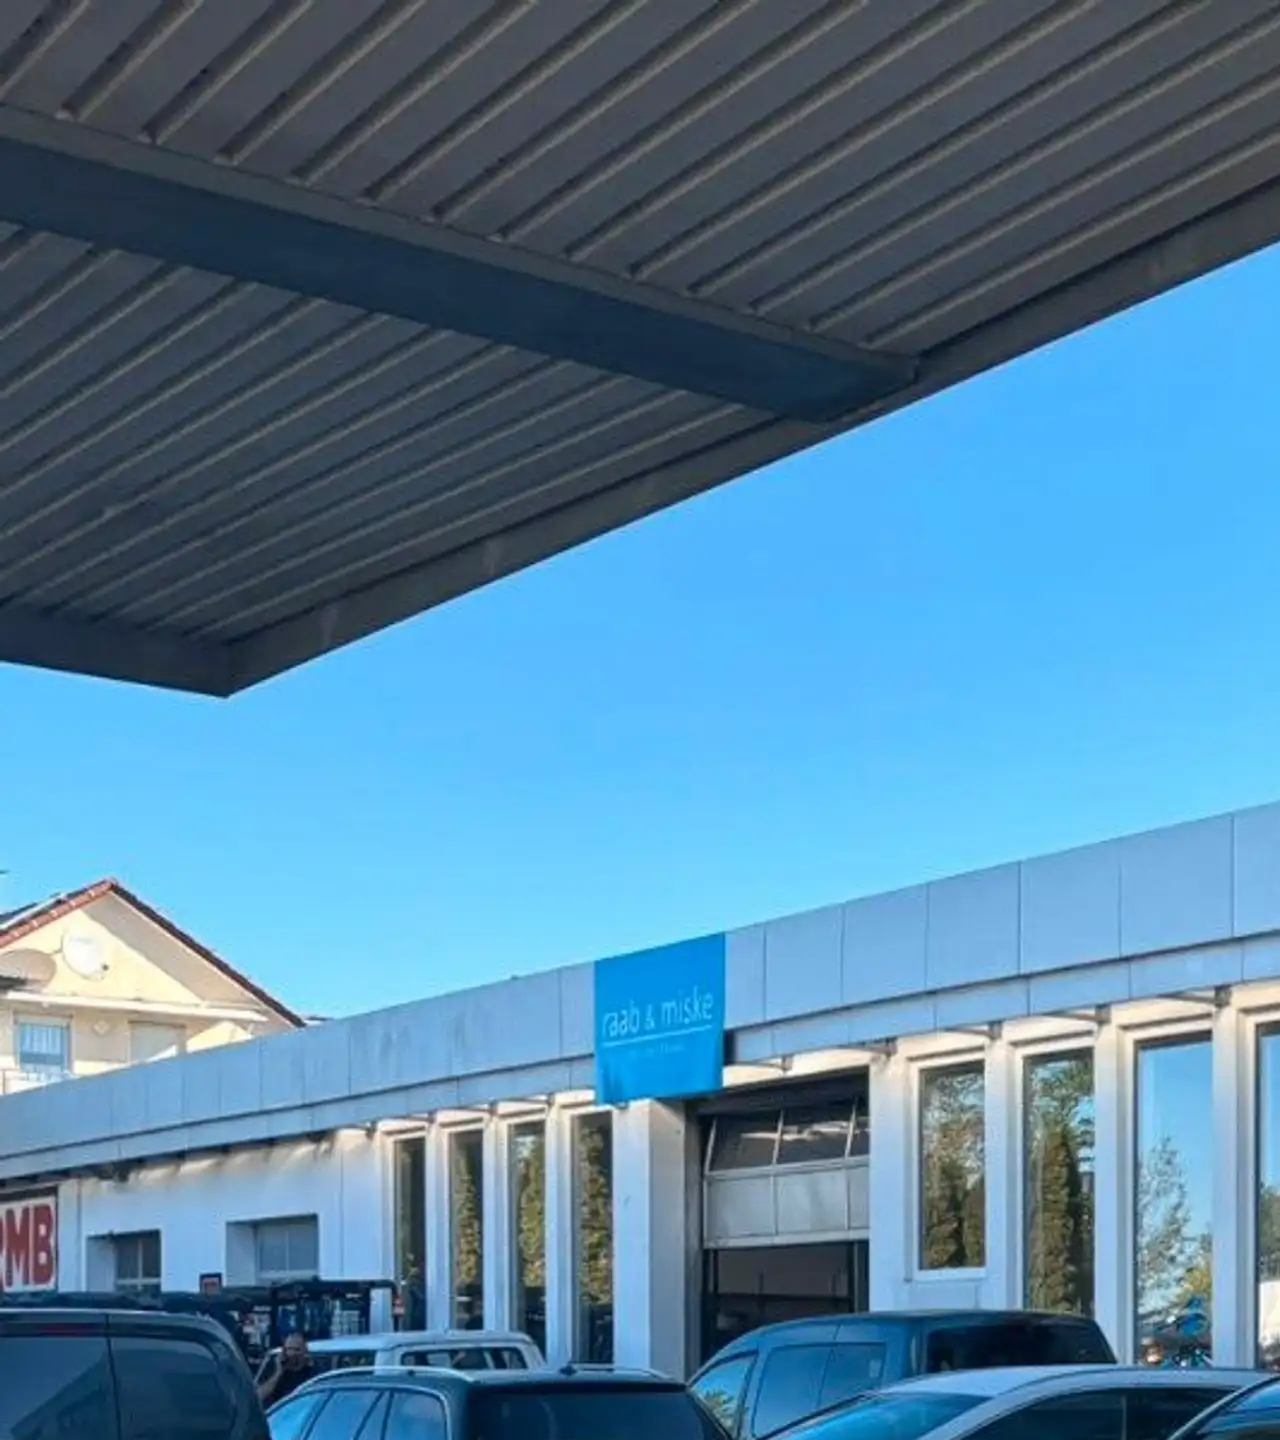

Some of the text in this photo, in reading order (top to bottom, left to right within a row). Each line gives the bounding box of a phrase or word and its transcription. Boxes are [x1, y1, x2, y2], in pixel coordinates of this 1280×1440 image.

[602, 1000, 640, 1039] raab
[660, 985, 714, 1026] miske
[0, 1204, 54, 1289] MB
